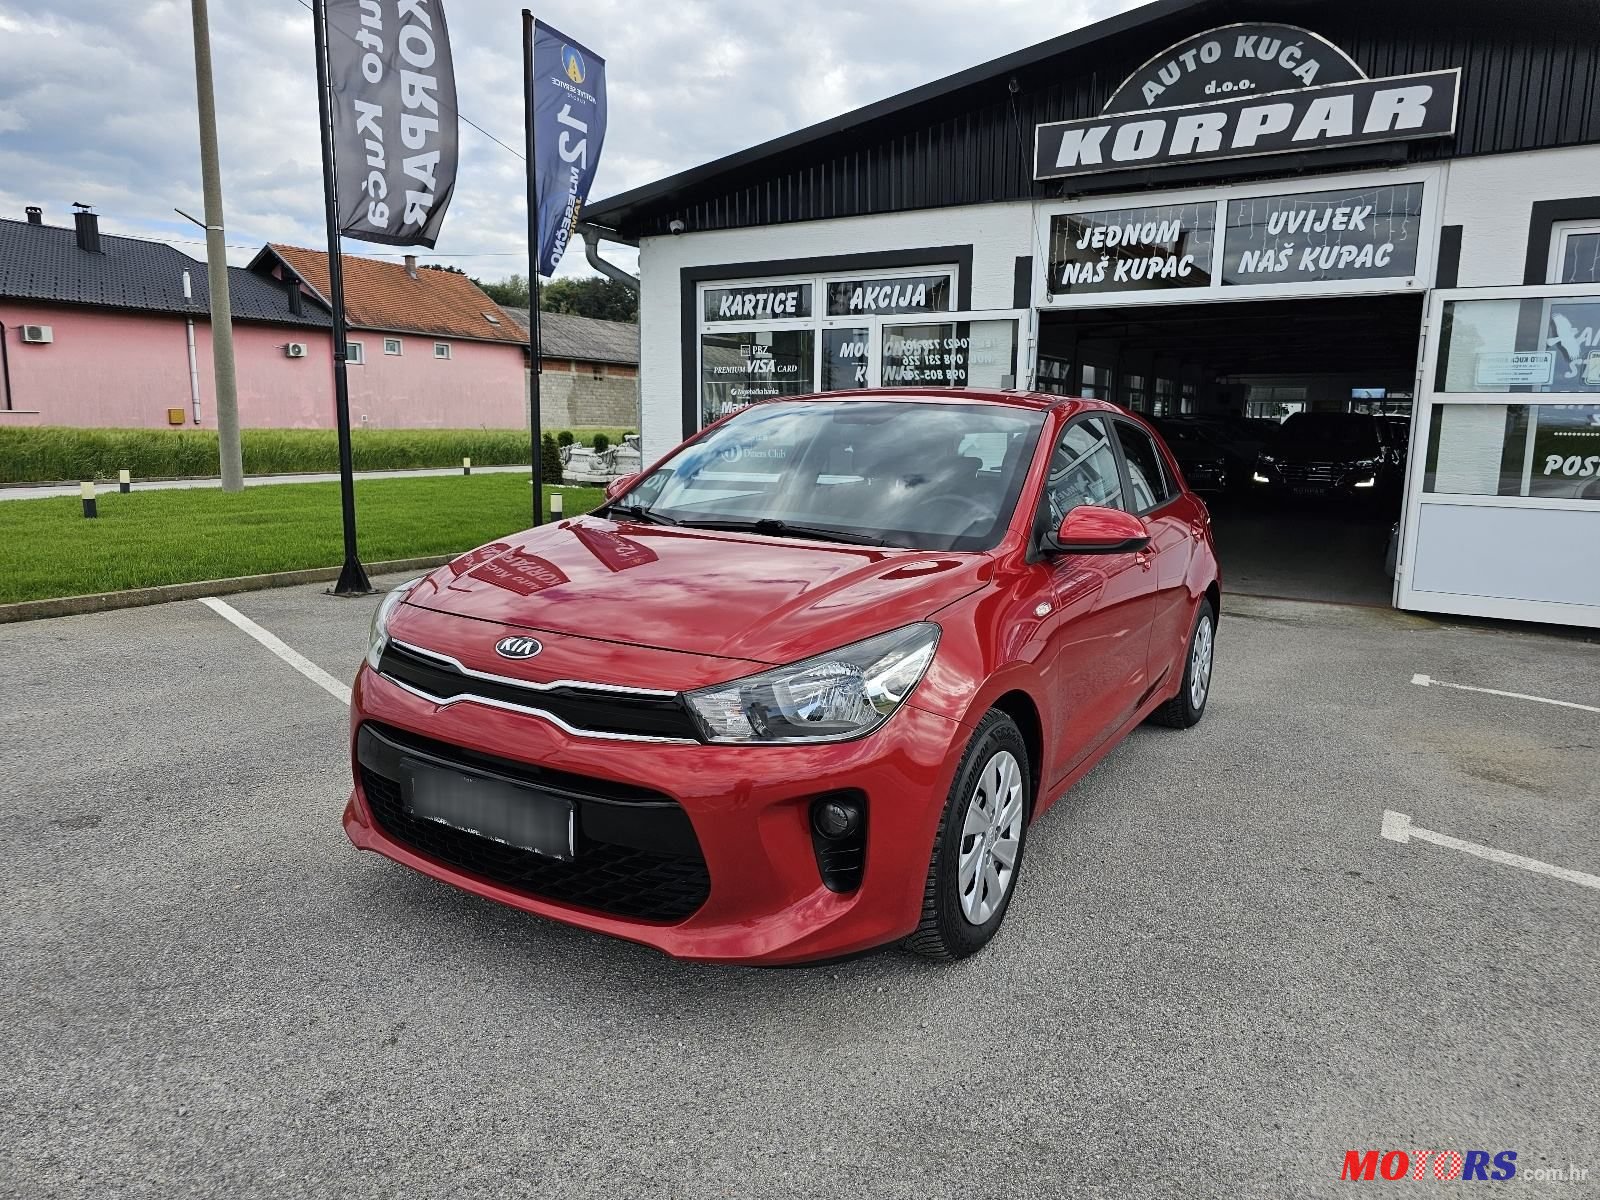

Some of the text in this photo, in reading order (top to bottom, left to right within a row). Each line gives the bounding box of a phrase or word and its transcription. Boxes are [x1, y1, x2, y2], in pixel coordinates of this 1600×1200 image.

[1141, 35, 1321, 106] AUTO KUĆA
[1204, 79, 1256, 95] d.o.o.
[1055, 84, 1433, 168] KORPAR
[1268, 205, 1373, 236] UVIJEK
[1076, 219, 1181, 250] JEDNOM
[1061, 254, 1195, 285] NAŠ KUPAC
[1237, 243, 1395, 274] NAŠ KUPAC
[719, 291, 798, 317] KARTICE
[849, 283, 926, 310] AKCIJA
[752, 345, 768, 355] PBZ
[713, 359, 798, 374] PREMIUM VISA CARD
[1543, 454, 1600, 477] POS
[500, 638, 533, 654] KIA
